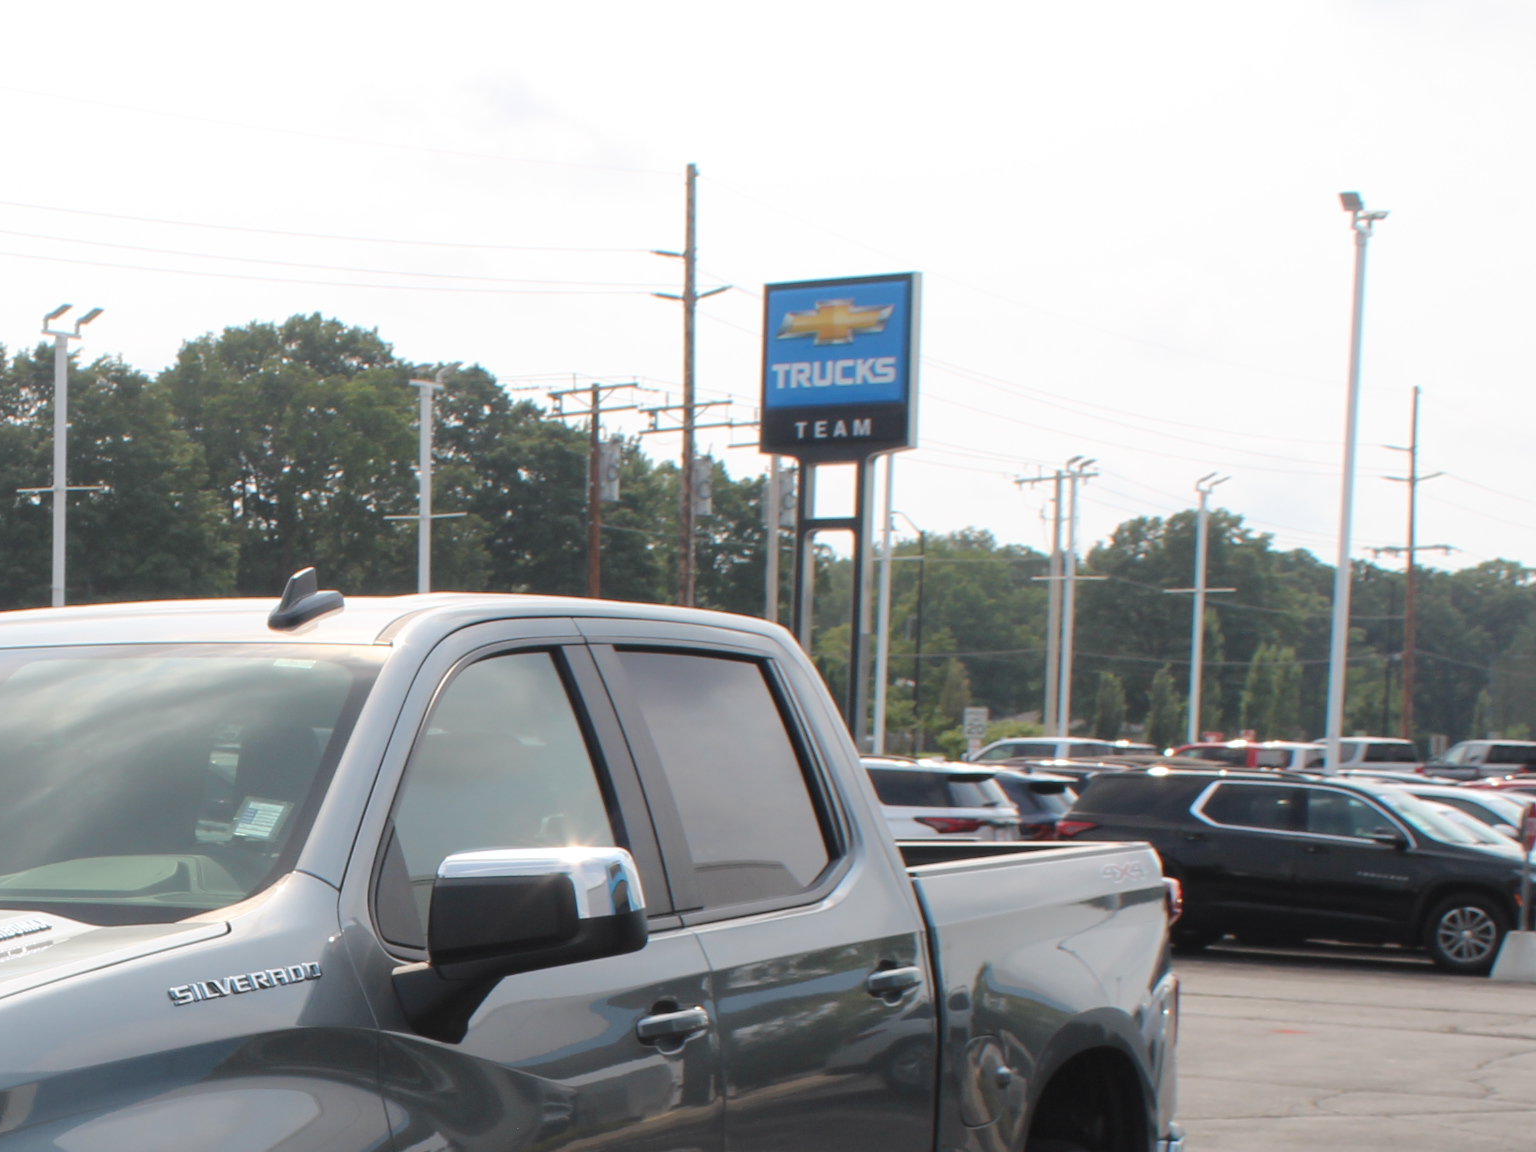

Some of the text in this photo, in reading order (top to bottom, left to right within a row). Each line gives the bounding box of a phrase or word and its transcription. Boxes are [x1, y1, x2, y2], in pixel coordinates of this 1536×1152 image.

[771, 356, 897, 389] TRUCKS
[794, 417, 872, 440] TEAM
[168, 961, 323, 1007] SILVERADO
